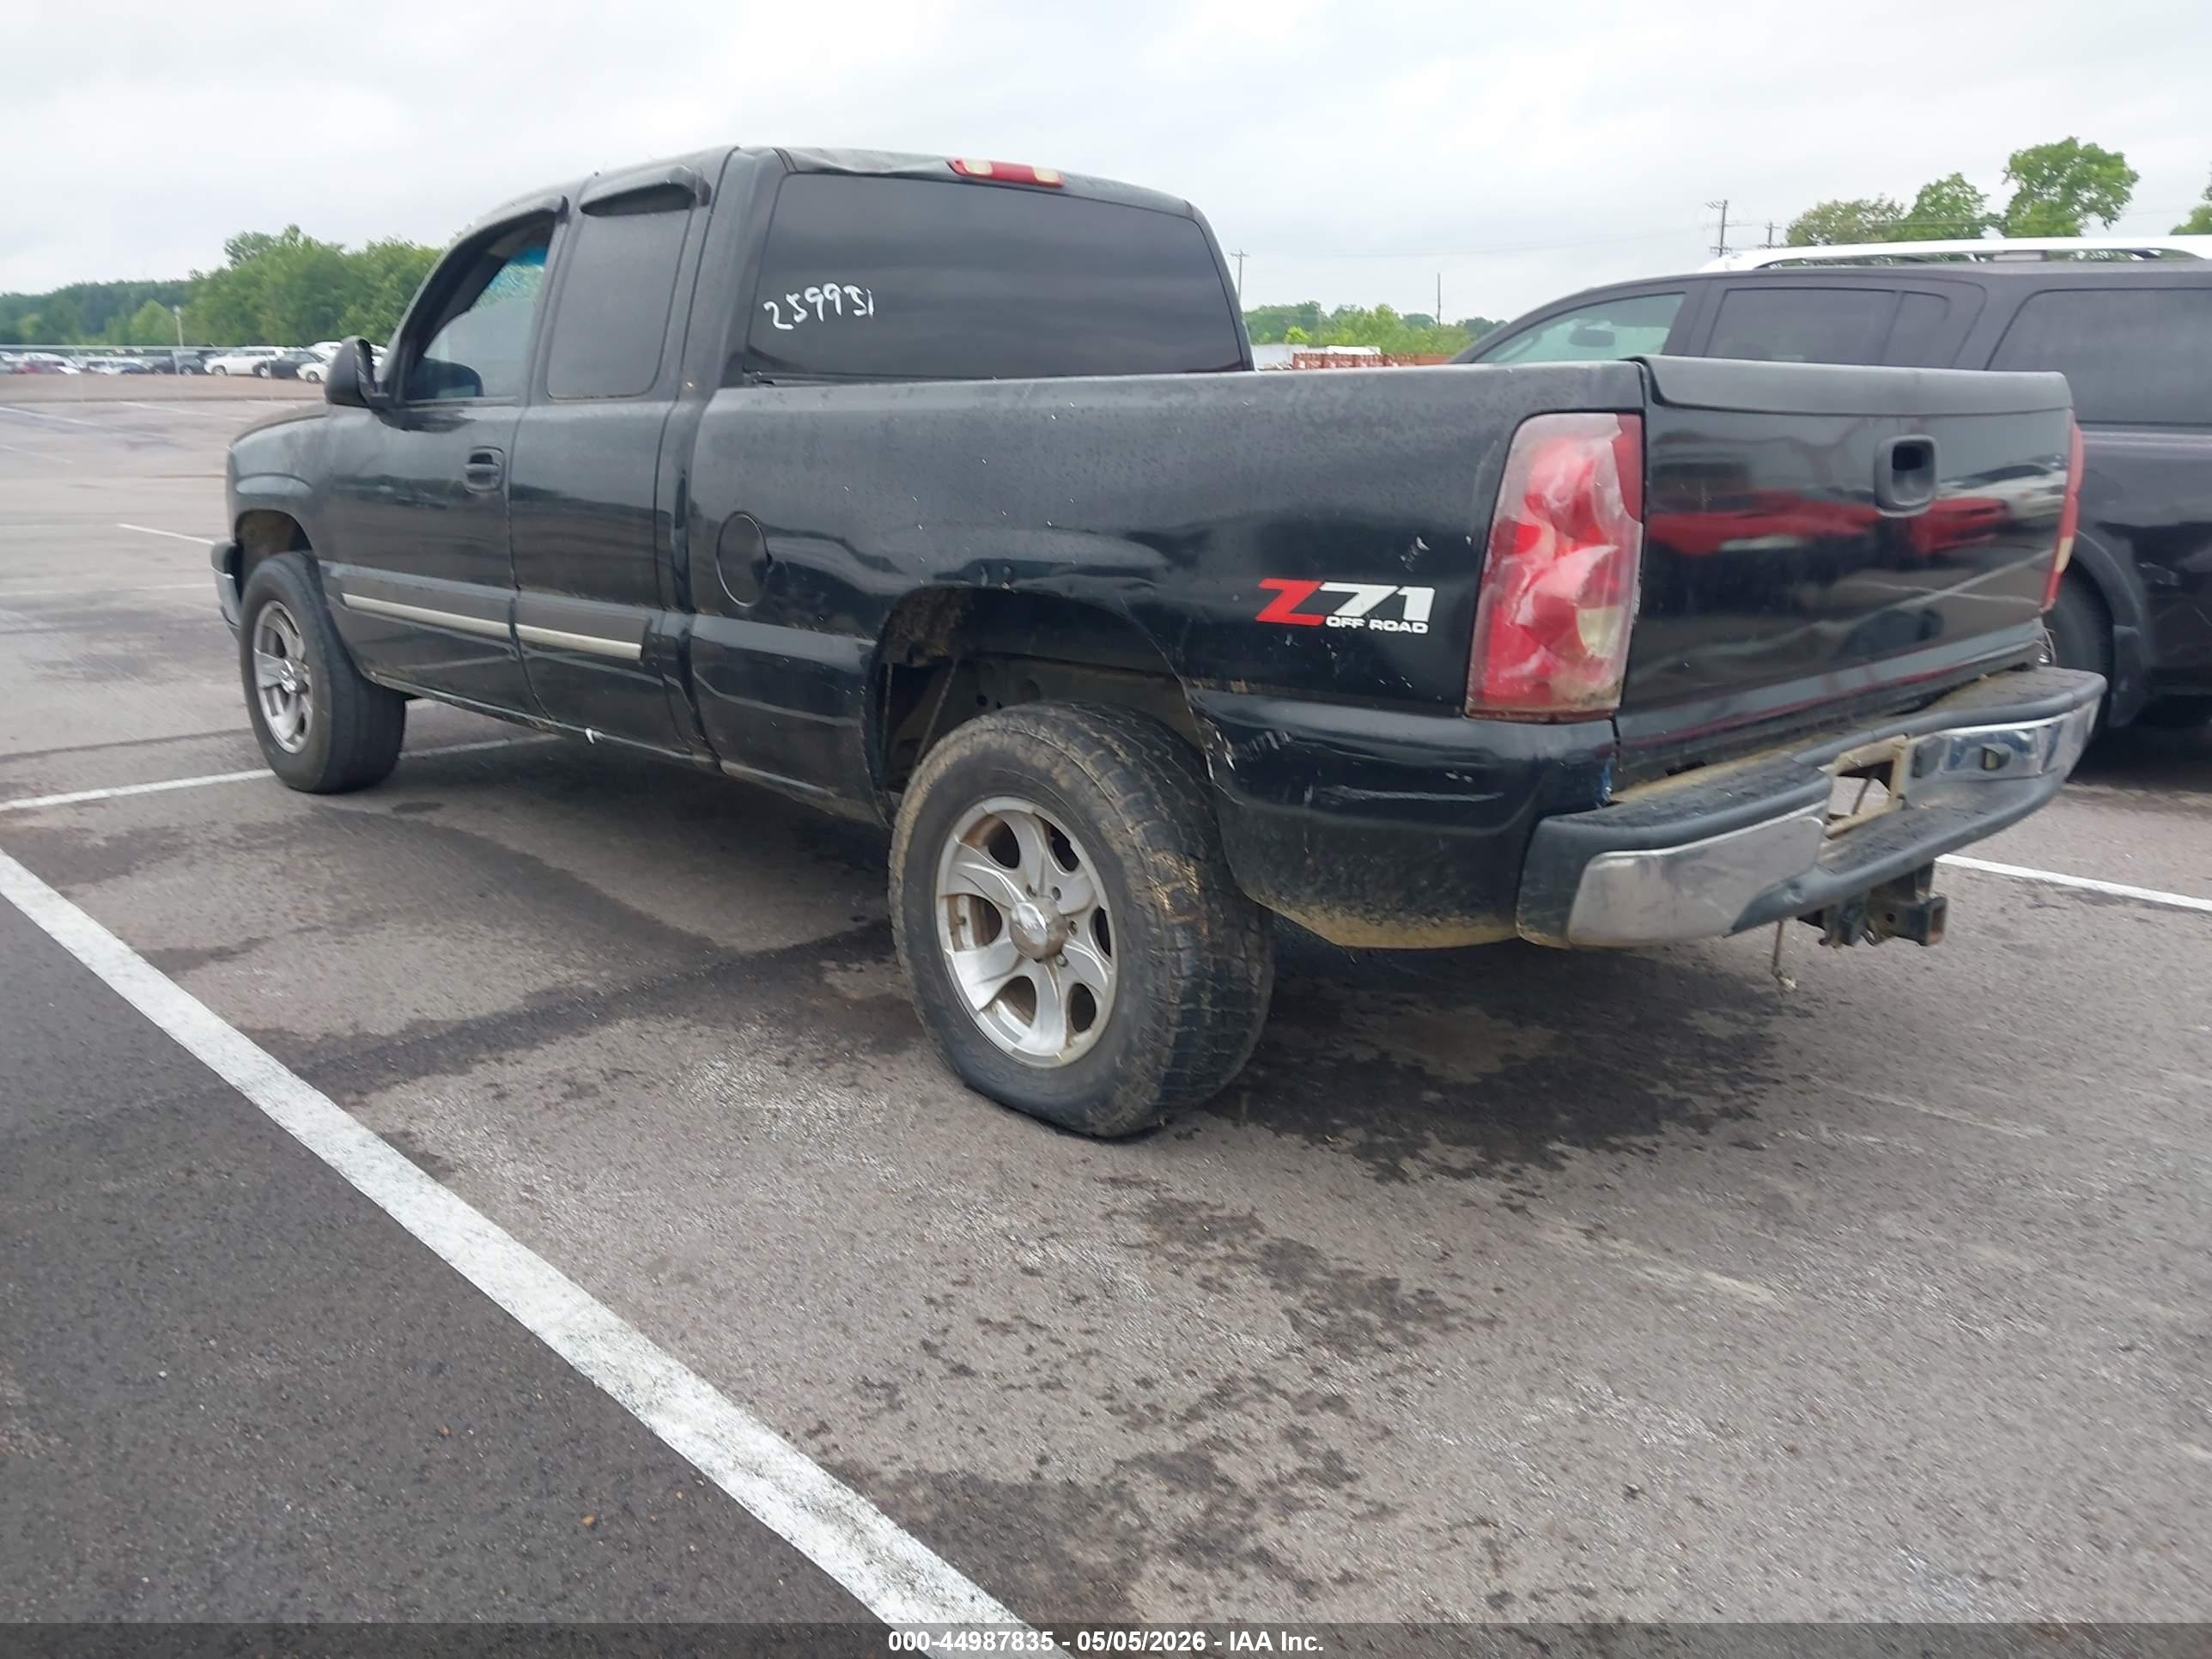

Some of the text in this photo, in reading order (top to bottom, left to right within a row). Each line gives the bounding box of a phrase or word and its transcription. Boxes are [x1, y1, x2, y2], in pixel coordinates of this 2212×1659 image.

[763, 282, 874, 331] 259951
[1255, 577, 1436, 626] Z71
[1326, 617, 1429, 634] OFF ROAD
